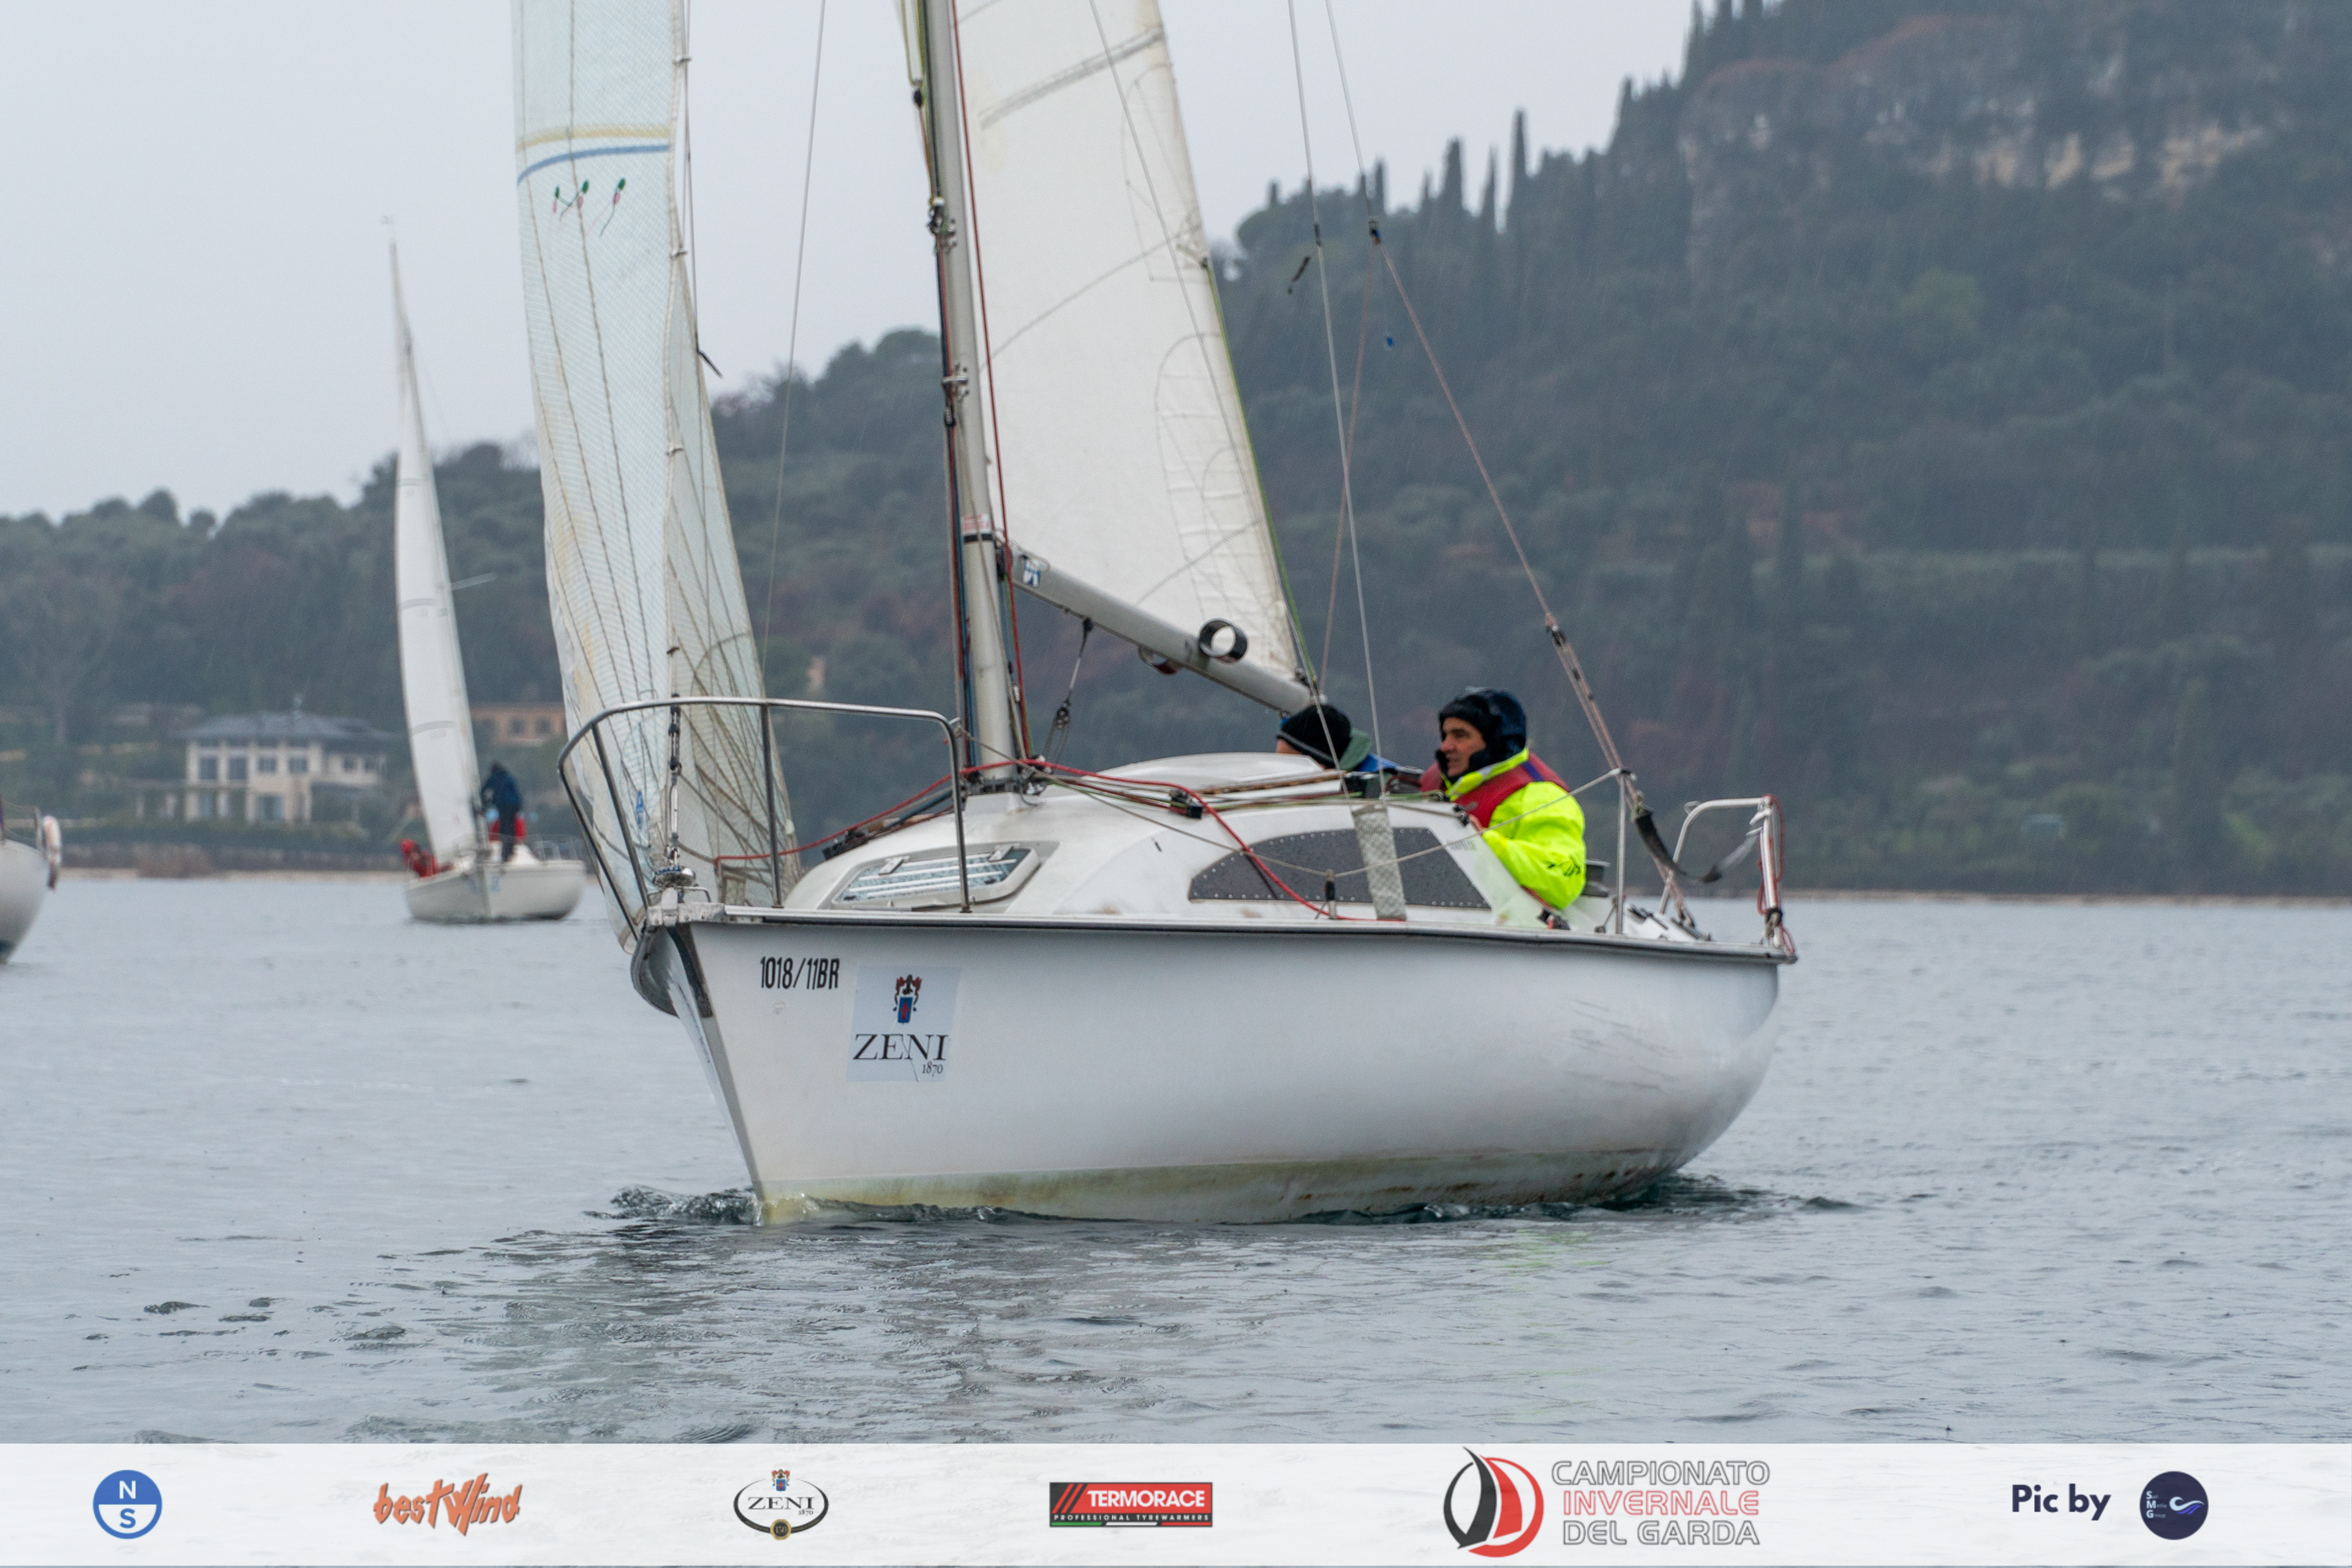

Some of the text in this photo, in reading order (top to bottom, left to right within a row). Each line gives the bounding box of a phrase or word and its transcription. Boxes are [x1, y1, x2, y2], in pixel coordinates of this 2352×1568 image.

[760, 956, 840, 990] 1018/11BR
[853, 1033, 949, 1060] ZENI
[922, 1060, 943, 1077] 1870
